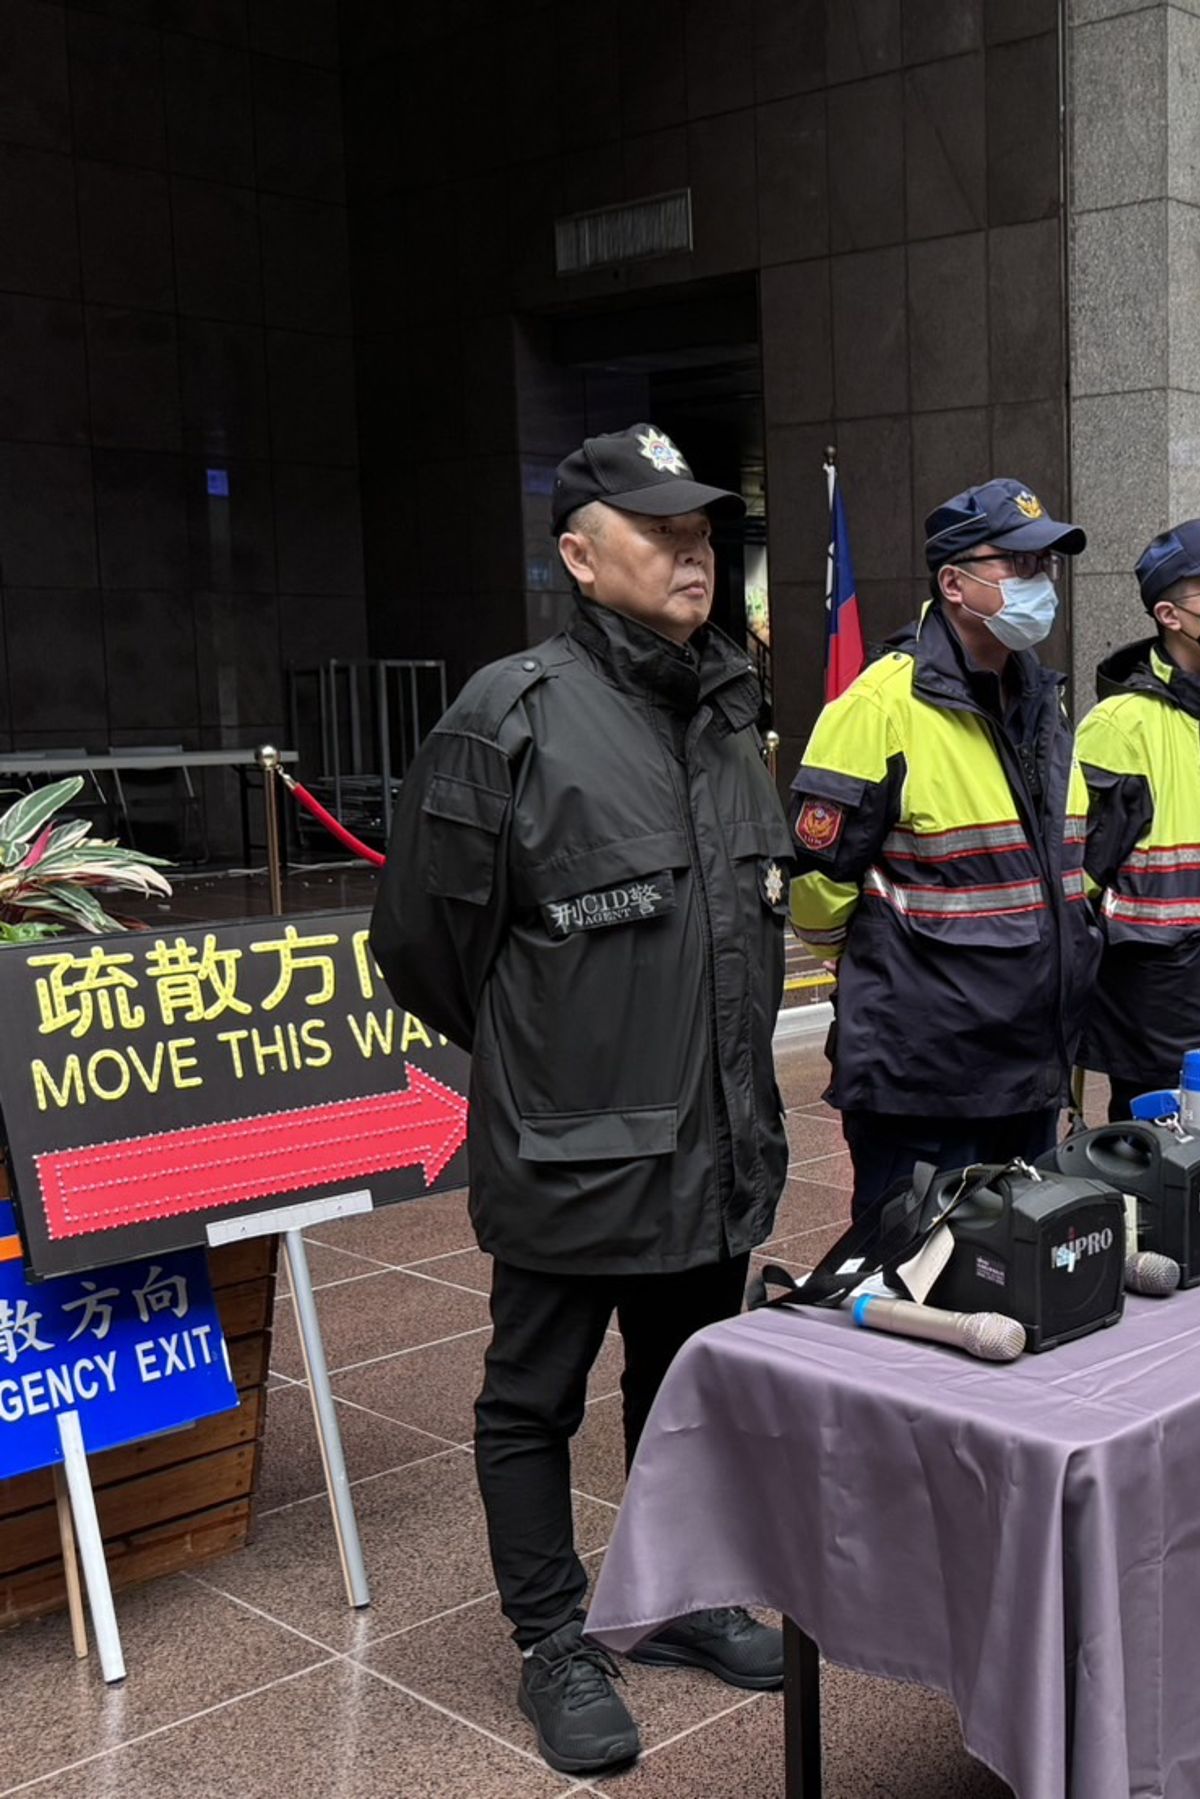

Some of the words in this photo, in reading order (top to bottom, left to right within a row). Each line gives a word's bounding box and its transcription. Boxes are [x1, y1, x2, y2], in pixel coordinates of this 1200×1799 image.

[31, 1037, 203, 1111] MOVE
[217, 1018, 333, 1079] THIS
[346, 1007, 449, 1059] WA
[0, 1351, 117, 1422] GENCY
[135, 1325, 212, 1382] EXIT
